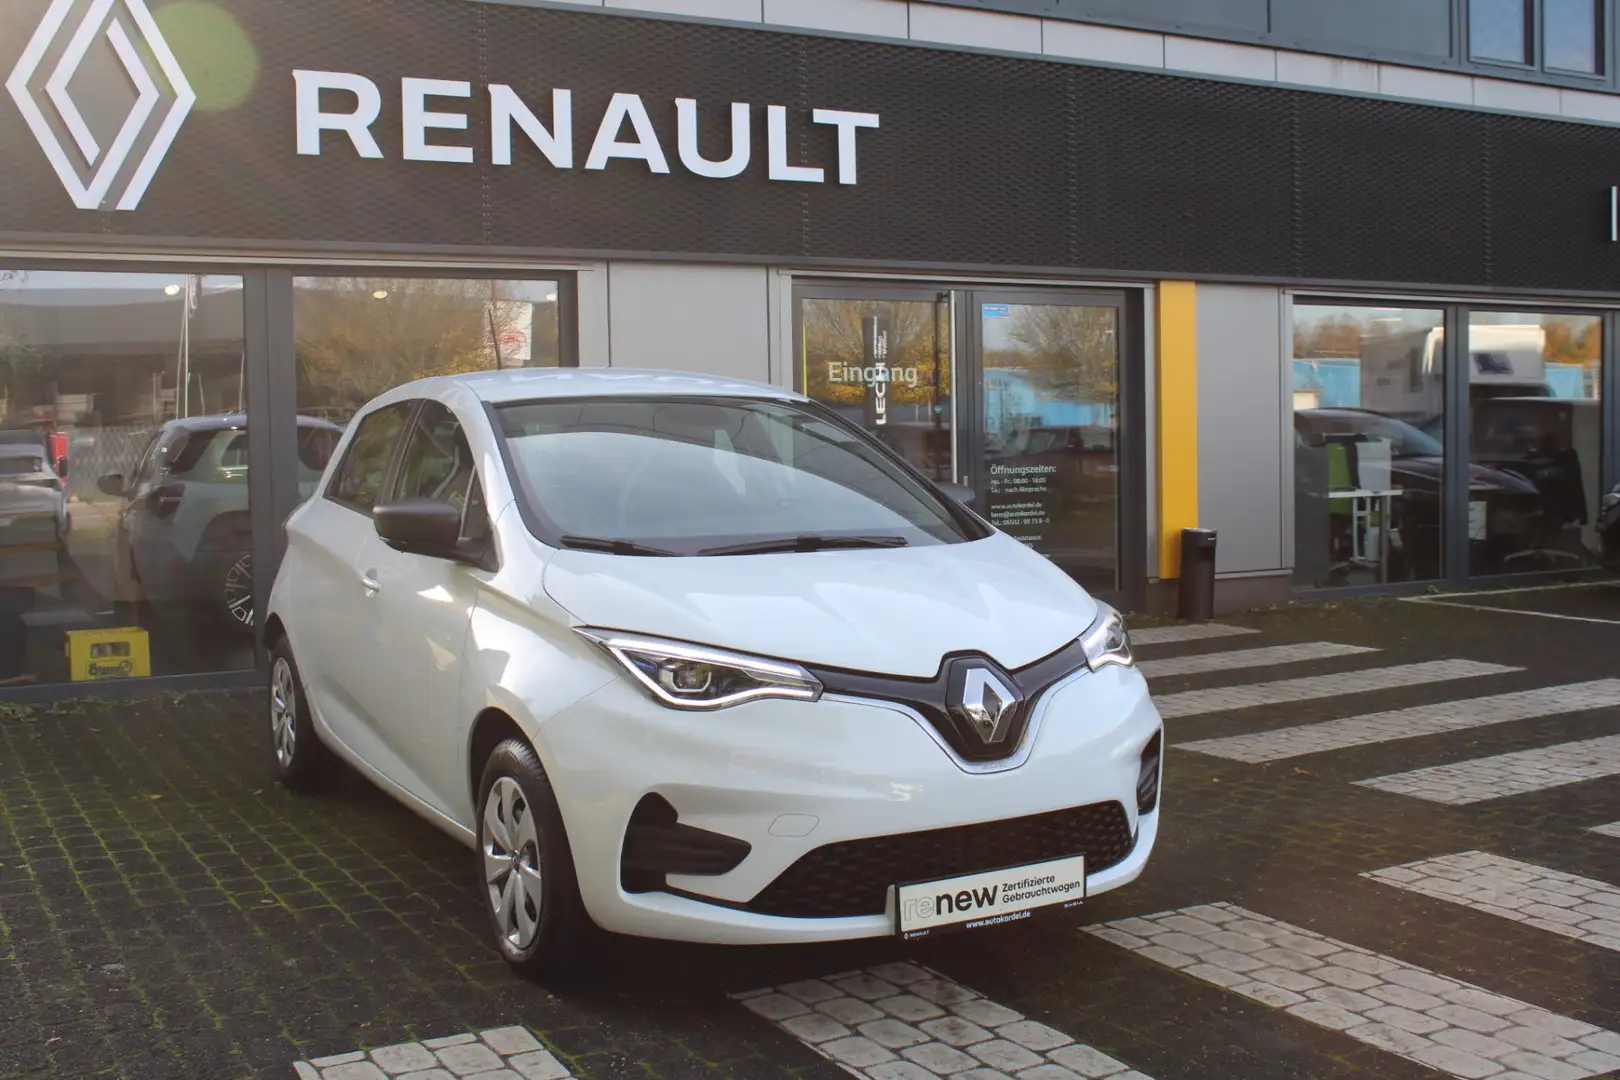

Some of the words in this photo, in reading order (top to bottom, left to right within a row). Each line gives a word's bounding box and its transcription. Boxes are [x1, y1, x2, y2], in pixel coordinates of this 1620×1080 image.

[292, 69, 880, 185] RENAULT
[828, 361, 918, 388] Eingang
[990, 464, 1057, 476] Öffnungszeiten:
[1002, 874, 1055, 893] Zertifizierte
[1002, 880, 1080, 904] Gebrauchtwagen
[904, 884, 998, 921] renew
[966, 910, 1031, 928] www.autokordel.de
